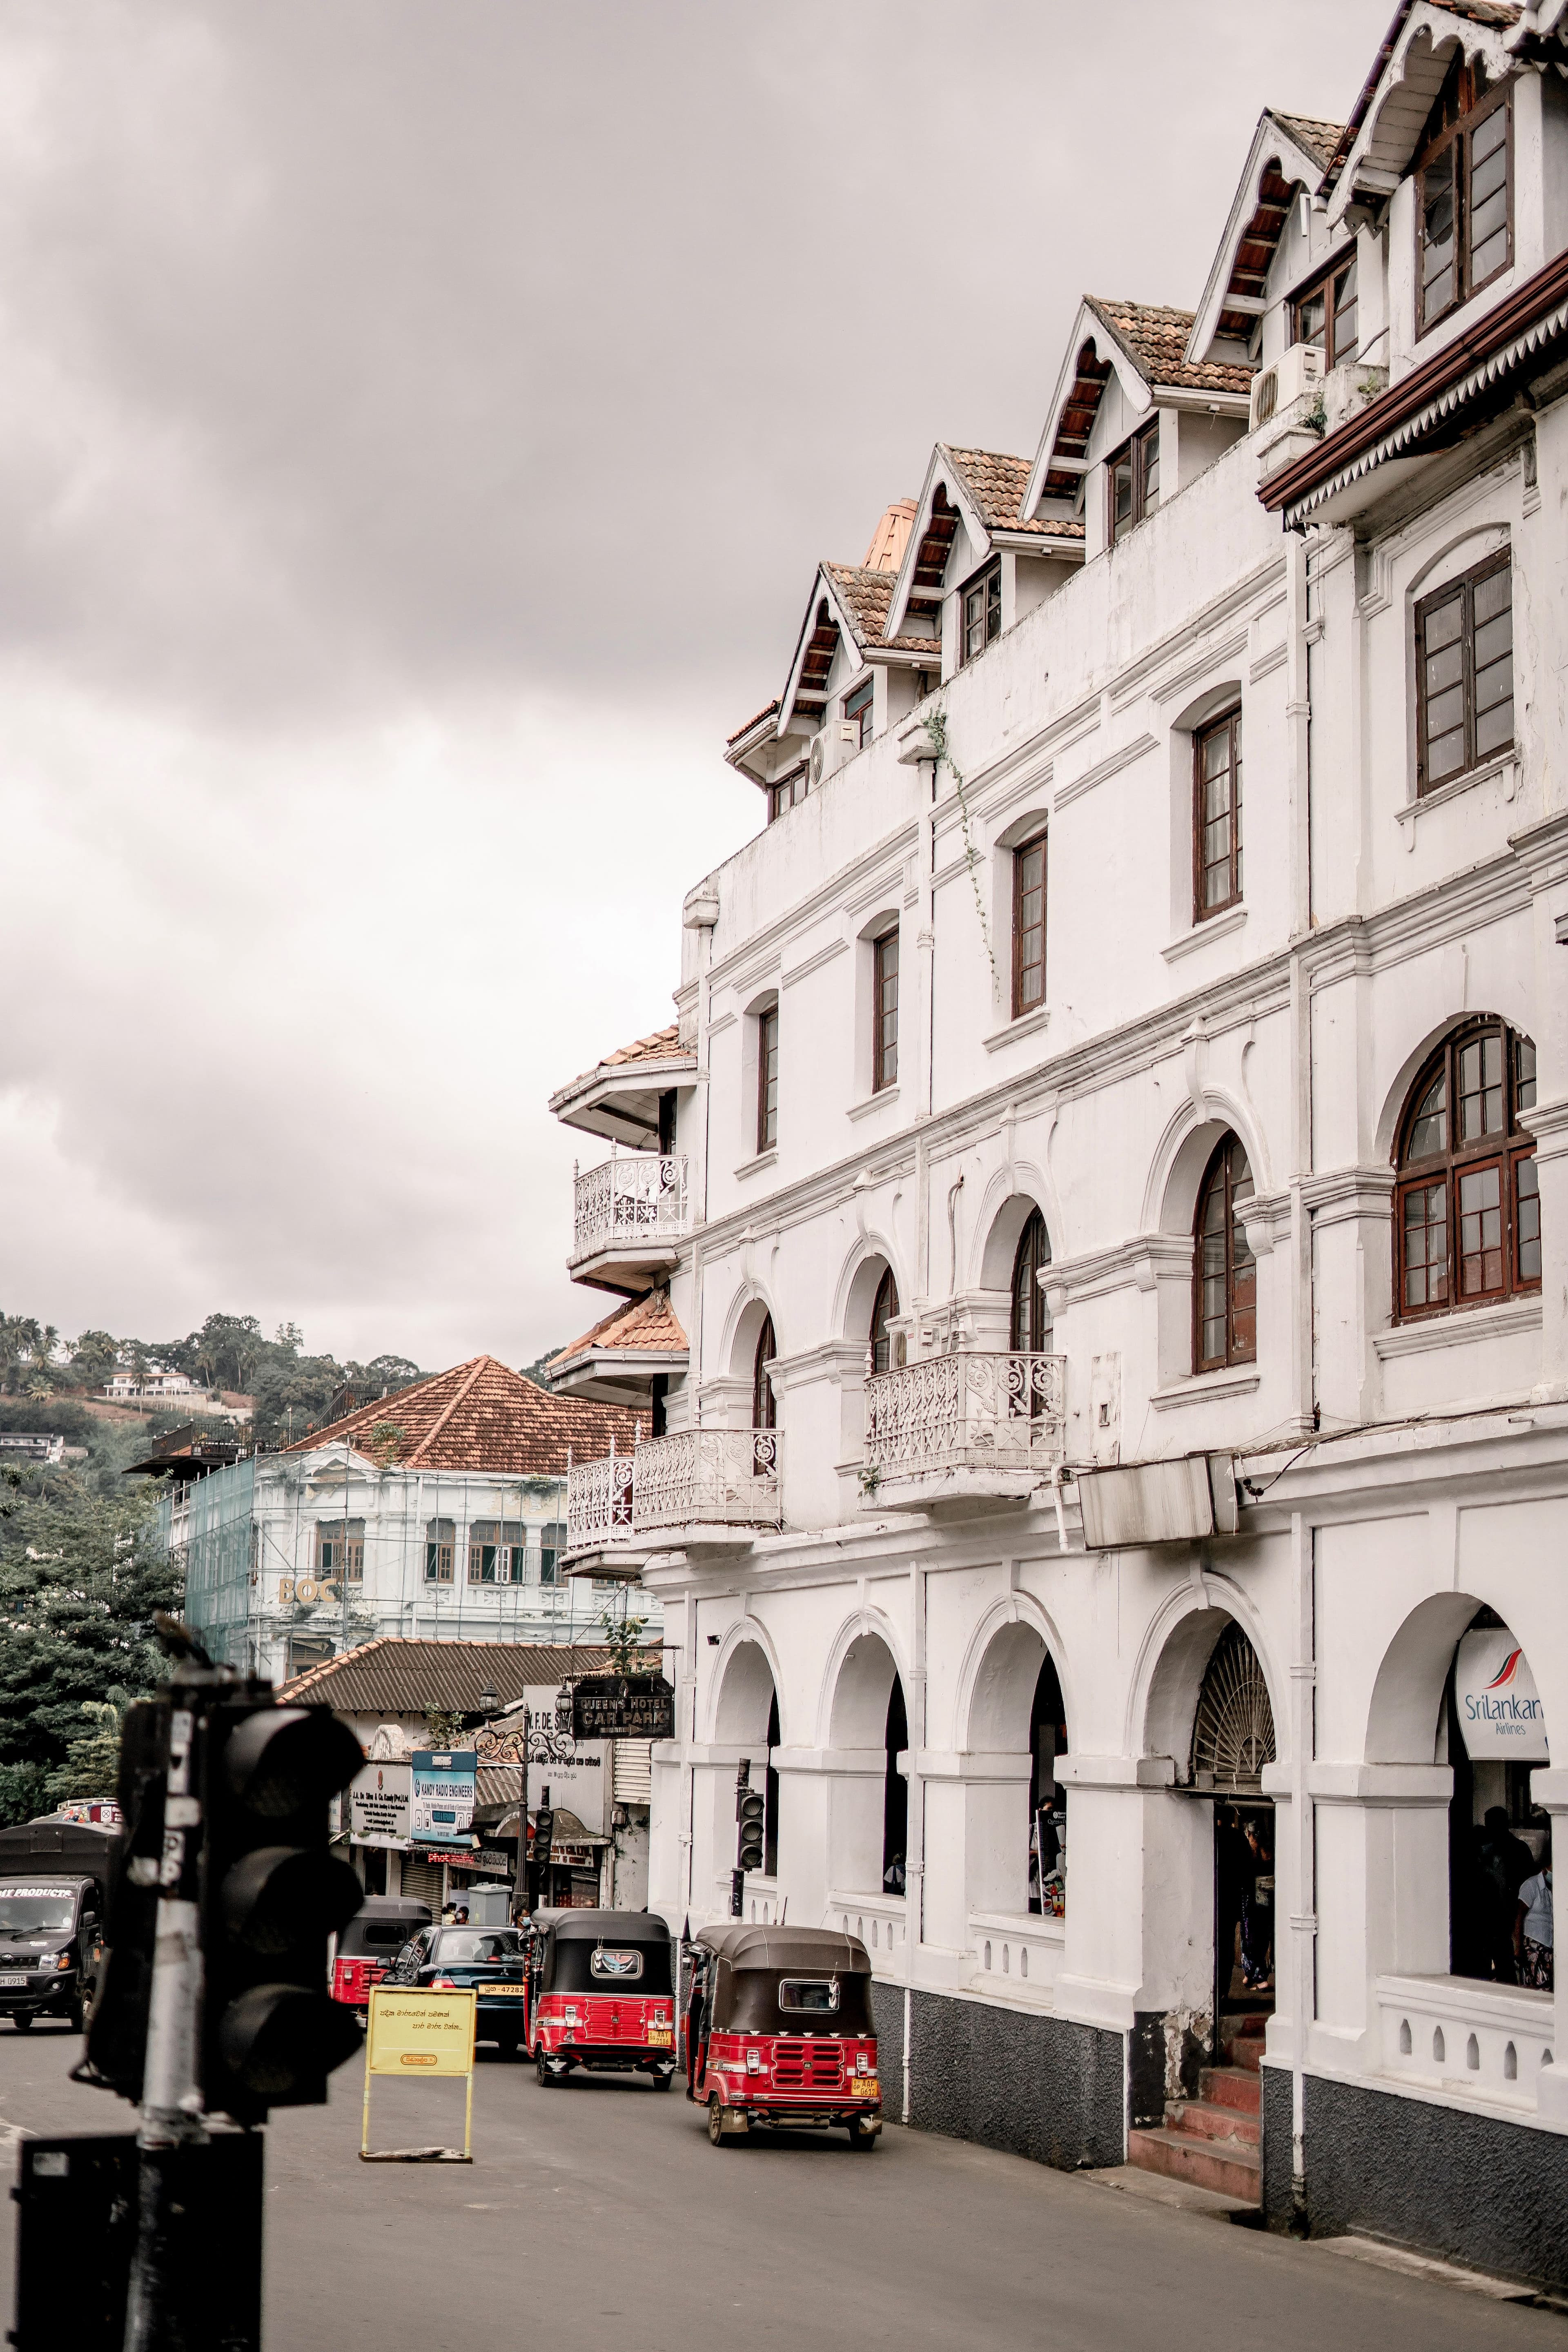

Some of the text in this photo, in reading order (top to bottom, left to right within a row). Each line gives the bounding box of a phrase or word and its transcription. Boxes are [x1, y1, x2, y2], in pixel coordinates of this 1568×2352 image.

[279, 1578, 336, 1604] BOC
[631, 1699, 666, 1708] HOTEL
[1466, 1694, 1544, 1719] SriLankan
[582, 1712, 664, 1725] CAR PARK
[1496, 1722, 1526, 1735] Airlines
[421, 1784, 435, 1795] KANDY
[436, 1784, 448, 1797] RADIO
[450, 1785, 472, 1798] ENGINEERS
